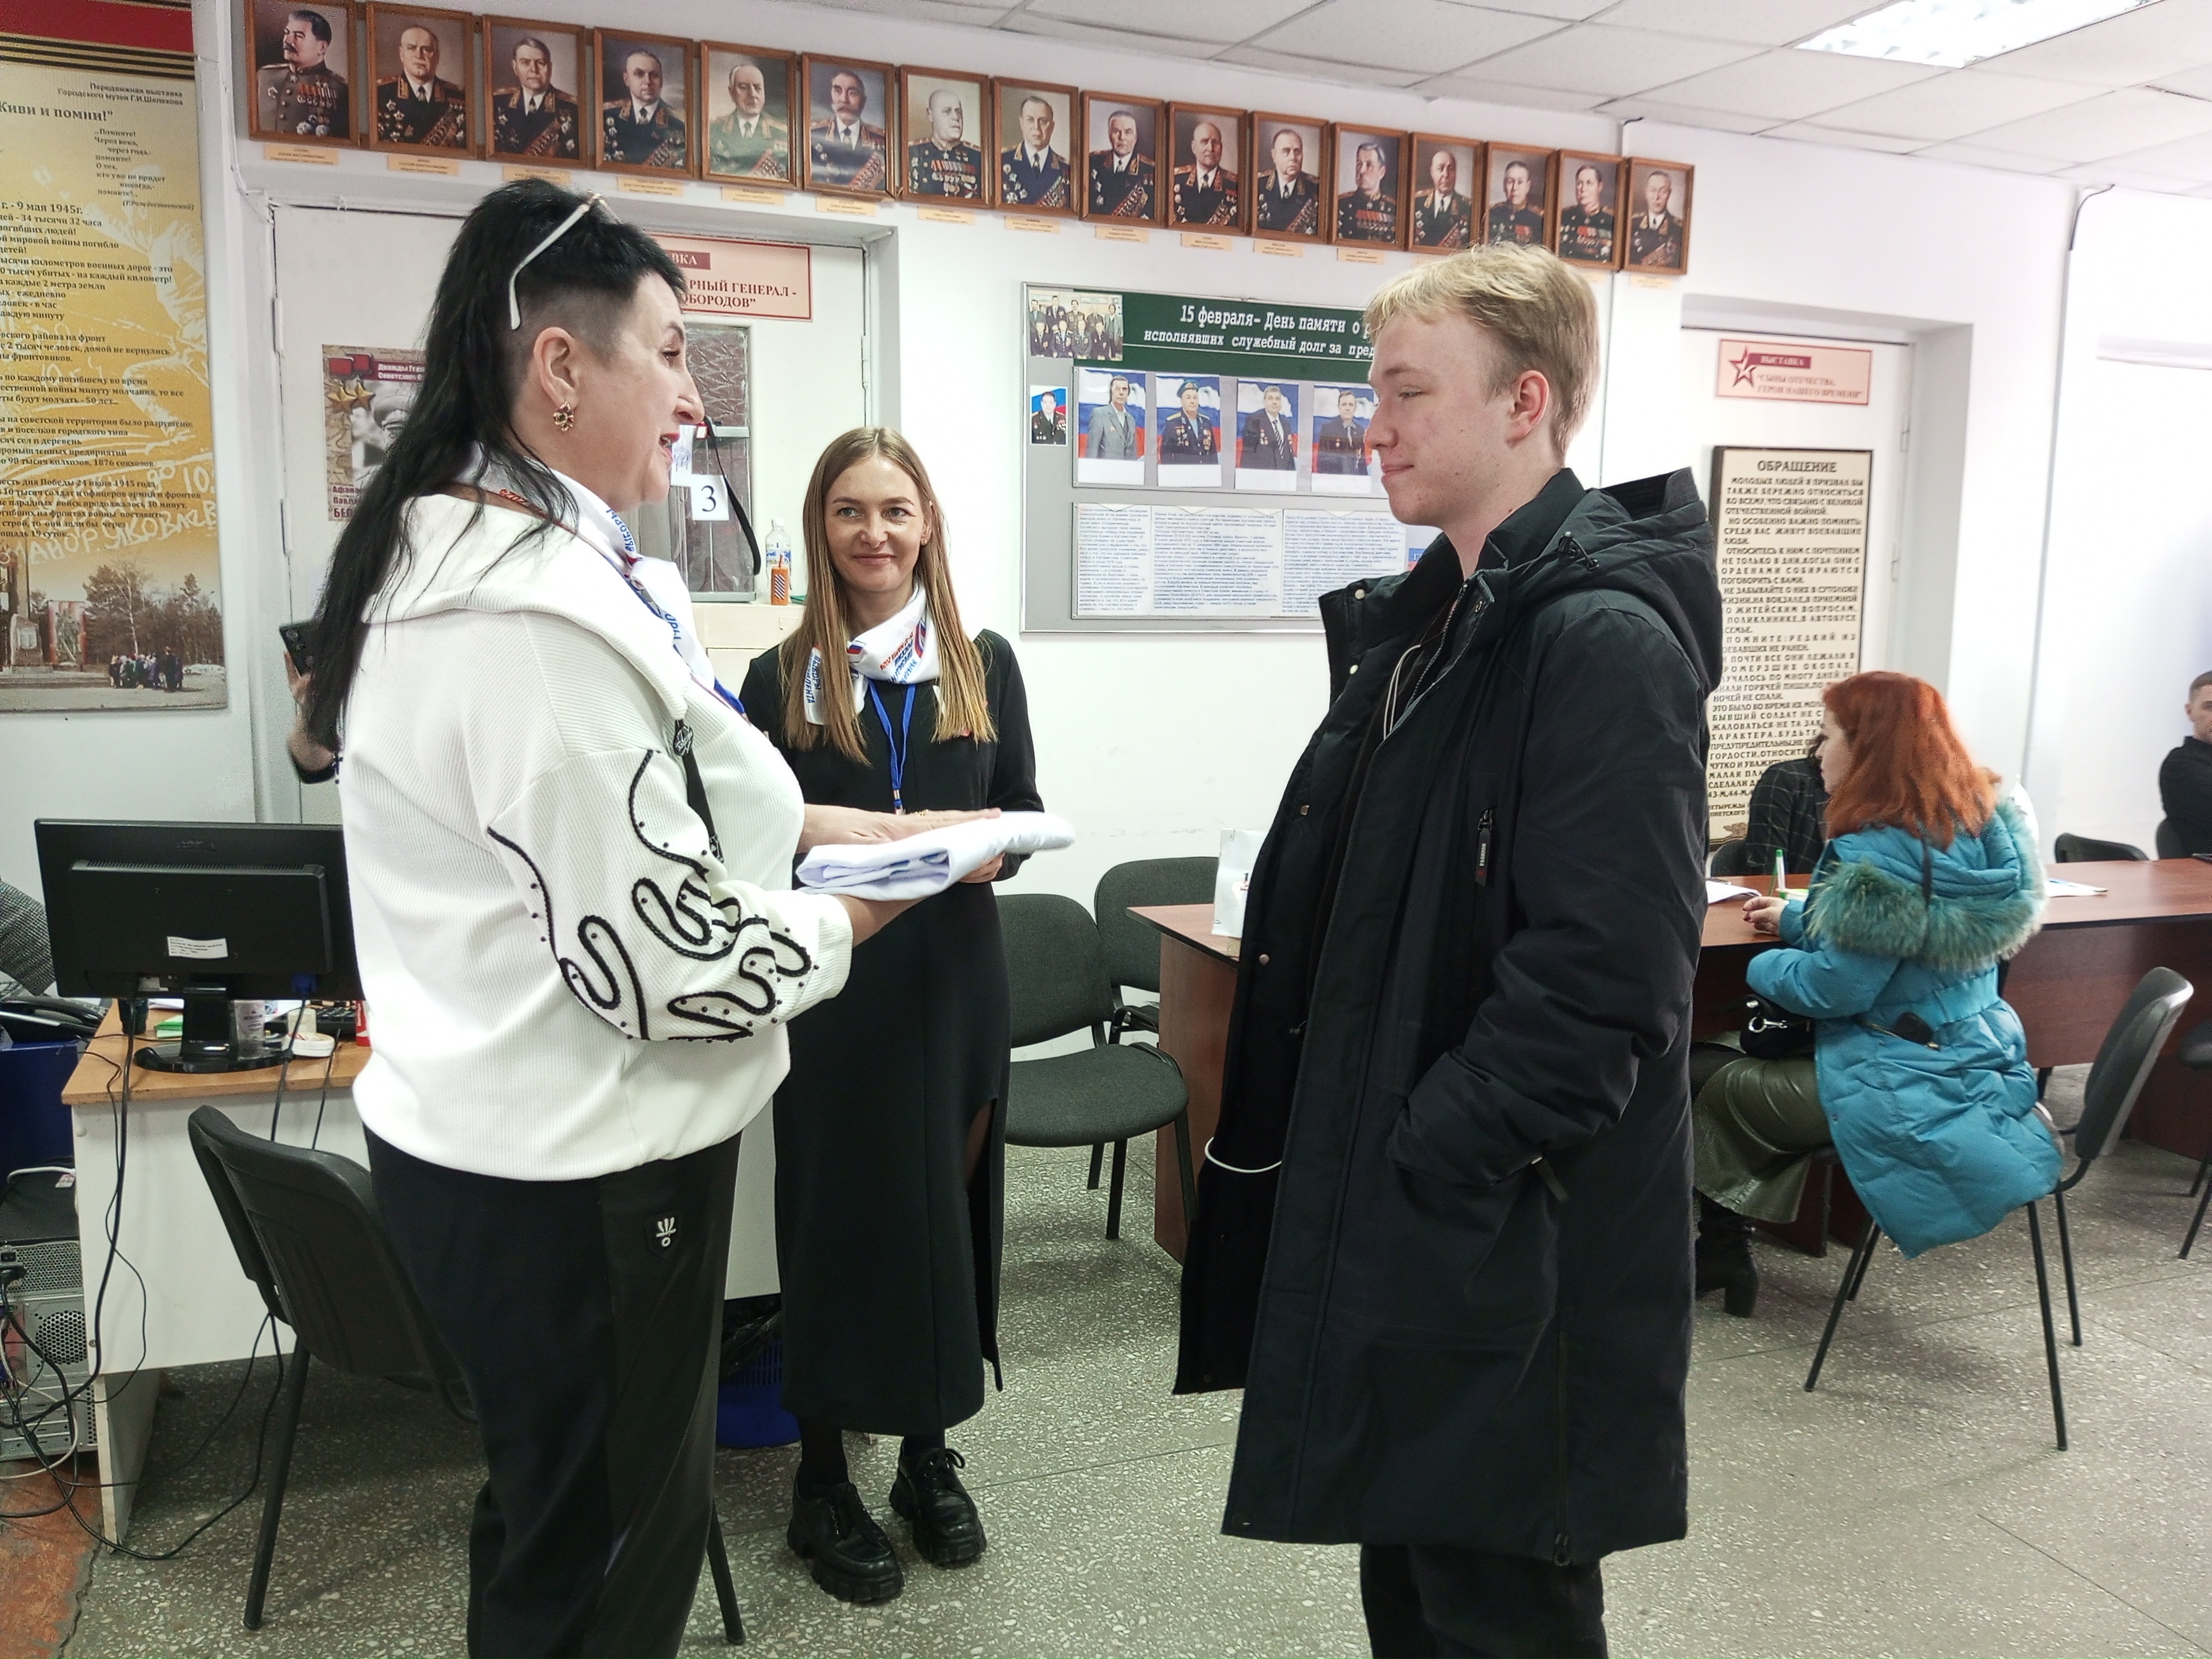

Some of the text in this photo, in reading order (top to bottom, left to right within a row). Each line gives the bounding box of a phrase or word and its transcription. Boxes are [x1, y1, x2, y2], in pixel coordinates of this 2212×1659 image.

[40, 107, 49, 116] и
[16, 199, 23, 210] 9
[27, 202, 47, 211] мая
[45, 225, 76, 236] людей!
[10, 235, 119, 248] мировой войны погибло
[671, 253, 697, 265] ВКА
[31, 260, 85, 269] километров
[127, 264, 151, 272] дорог
[37, 268, 70, 279] убитых
[89, 271, 125, 281] каждый
[127, 273, 171, 284] километр!
[5, 279, 41, 287] каждые
[50, 281, 77, 290] метра
[690, 279, 789, 297] РНЫЙ ГЕНЕРАЛ
[32, 312, 64, 321] минуту
[1180, 305, 1195, 322] 15
[1264, 312, 1295, 331] День
[1298, 317, 1346, 333] памяти
[1352, 321, 1360, 334] о
[32, 331, 64, 342] района
[78, 334, 105, 343] фронт
[1144, 329, 1224, 346] исполнявших
[1231, 335, 1297, 351] служебный
[1299, 340, 1326, 354] долг
[1329, 344, 1342, 354] за
[84, 345, 112, 353] домой
[126, 348, 170, 357] вернулись
[11, 352, 72, 363] фронтовиков.
[78, 388, 109, 396] минуту
[20, 415, 64, 423] советской
[66, 419, 118, 427] территории
[1757, 460, 1835, 473] ОБРАЩЕНИЕ
[40, 478, 74, 487] Победы
[701, 485, 717, 512] 3
[1725, 506, 1791, 514] ОТЕЧЕСТВЕННОЙ
[1736, 604, 1797, 613] ЖИТЕЙСКИМ
[1744, 682, 1781, 691] ГОРЯЧЕЙ
[1713, 693, 1741, 701] НОЧЕЙ
[1712, 711, 1756, 721] БЫВШИЙ
[1760, 711, 1796, 720] СОЛДАТ
[1710, 761, 1743, 772] ЧУТКО И
[1709, 780, 1747, 789] СДЕЛАЛИ
